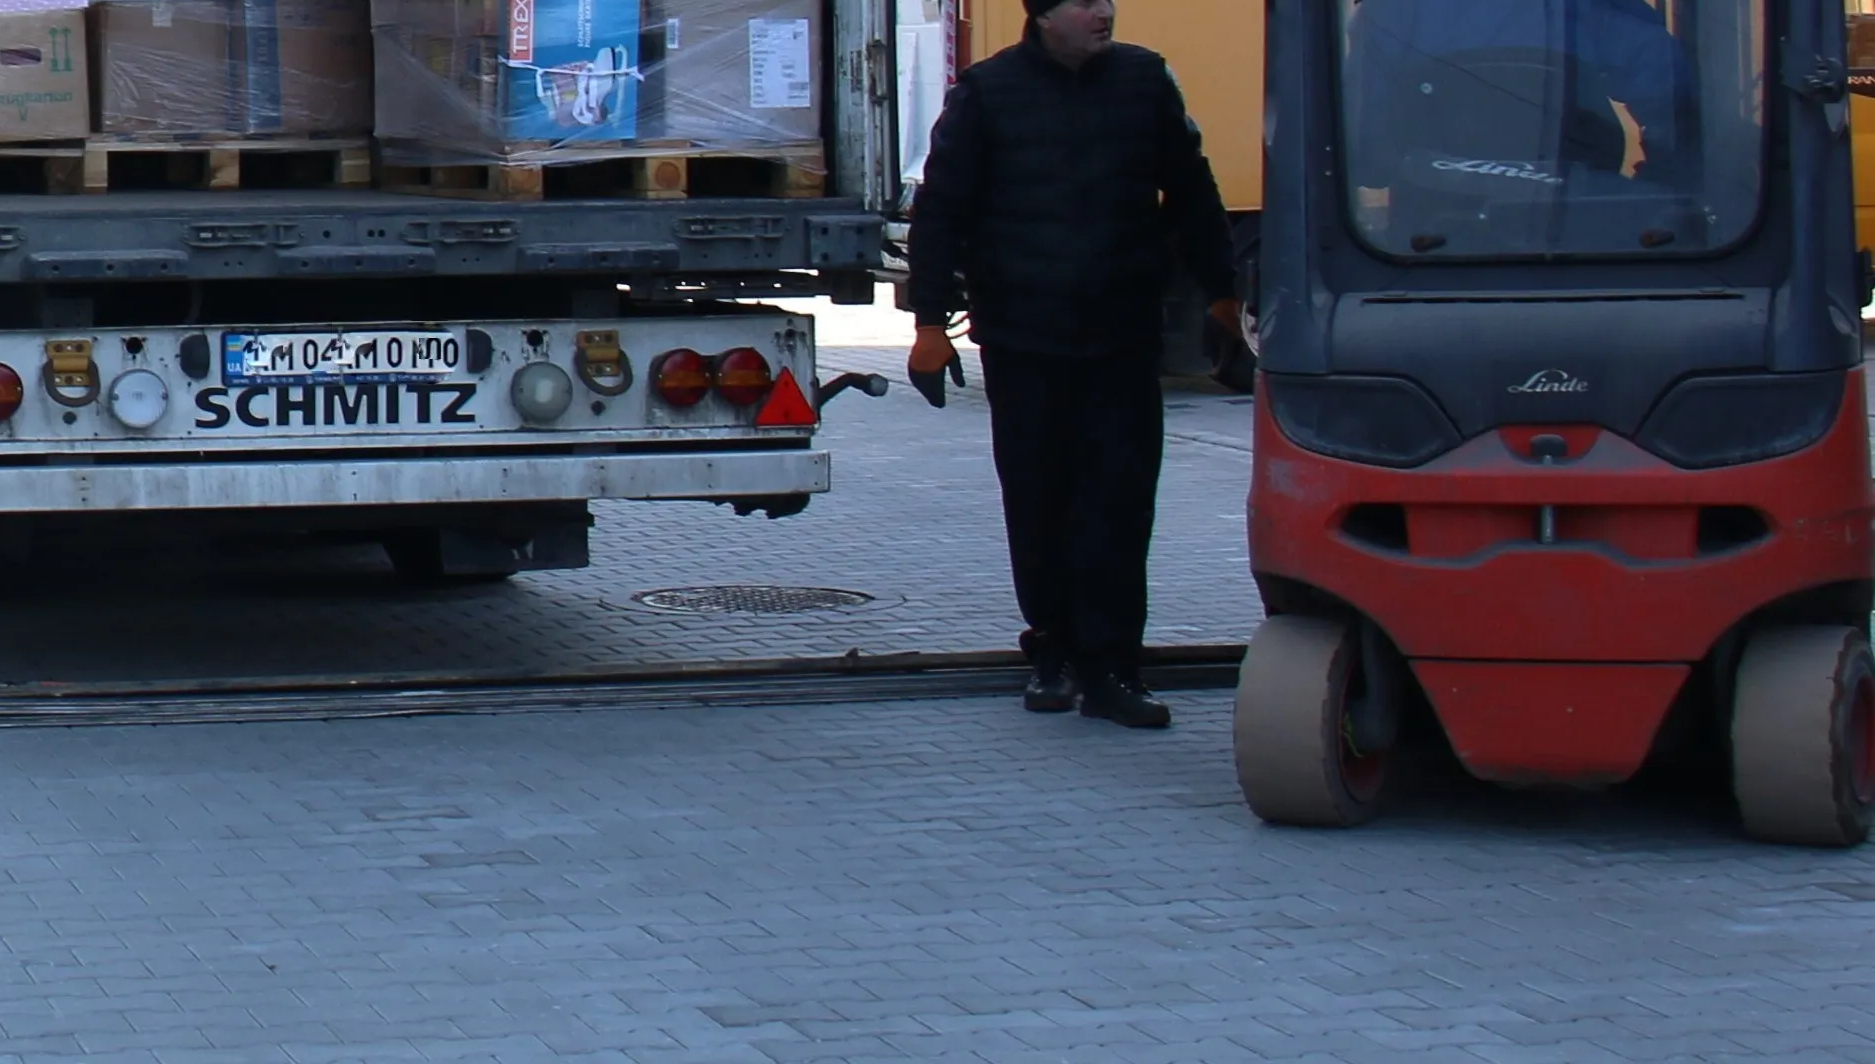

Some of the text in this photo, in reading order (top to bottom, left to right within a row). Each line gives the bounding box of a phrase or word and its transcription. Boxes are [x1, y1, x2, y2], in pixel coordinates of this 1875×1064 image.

[227, 362, 242, 373] UA
[1506, 368, 1589, 393] Linde
[195, 383, 476, 429] SCHMITZ
